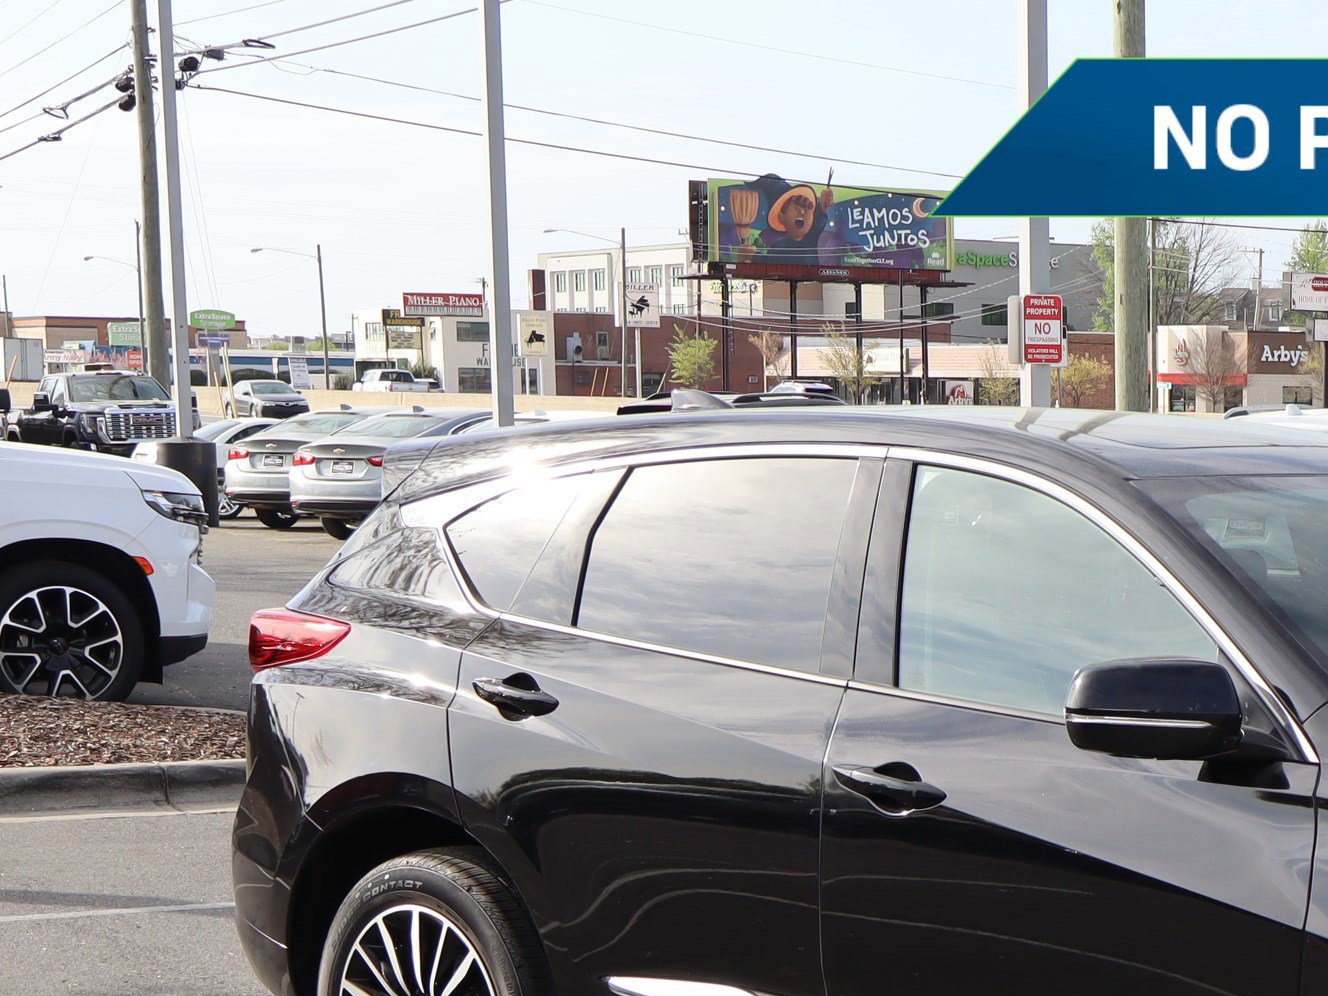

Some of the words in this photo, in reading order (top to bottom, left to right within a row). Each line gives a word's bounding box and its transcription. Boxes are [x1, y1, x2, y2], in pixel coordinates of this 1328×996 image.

[848, 207, 913, 229] LEAMOS
[927, 257, 944, 266] Read
[407, 295, 445, 306] MILLER
[449, 296, 480, 306] PIANO
[1030, 298, 1055, 306] PRIVATE
[1026, 308, 1059, 316] PROPERTY
[1034, 322, 1051, 335] NO
[1261, 344, 1309, 366] Arby's
